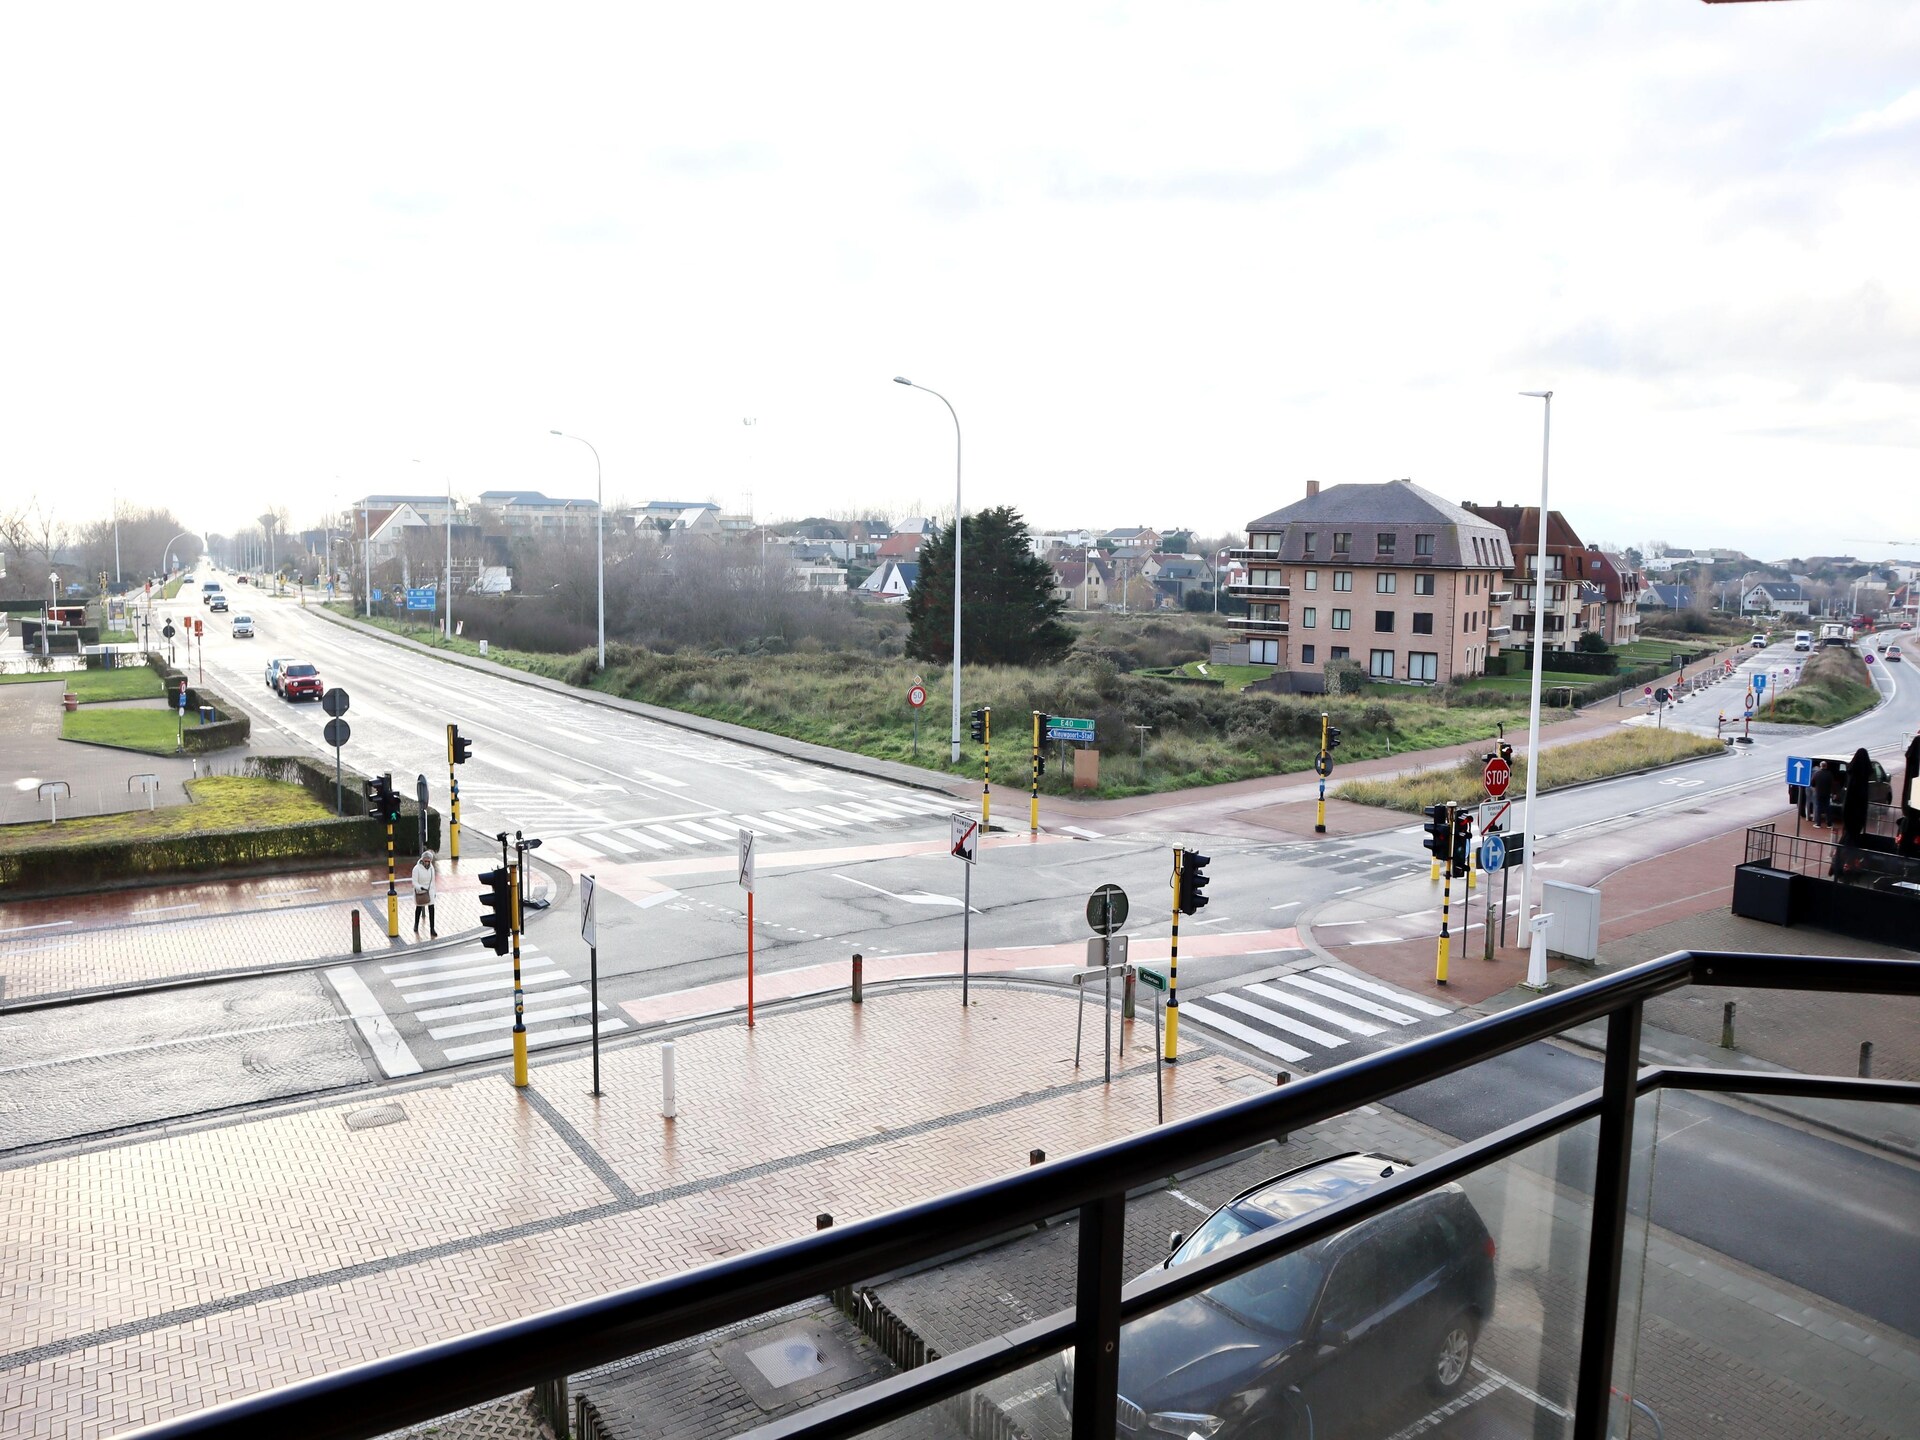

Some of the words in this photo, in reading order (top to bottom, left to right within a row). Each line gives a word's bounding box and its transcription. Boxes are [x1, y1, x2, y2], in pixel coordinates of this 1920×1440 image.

[913, 691, 922, 699] 50
[1060, 719, 1074, 728] E40
[1053, 730, 1093, 740] Nieuwpoort-Stad
[1486, 769, 1509, 786] STOP
[1658, 777, 1705, 787] 50
